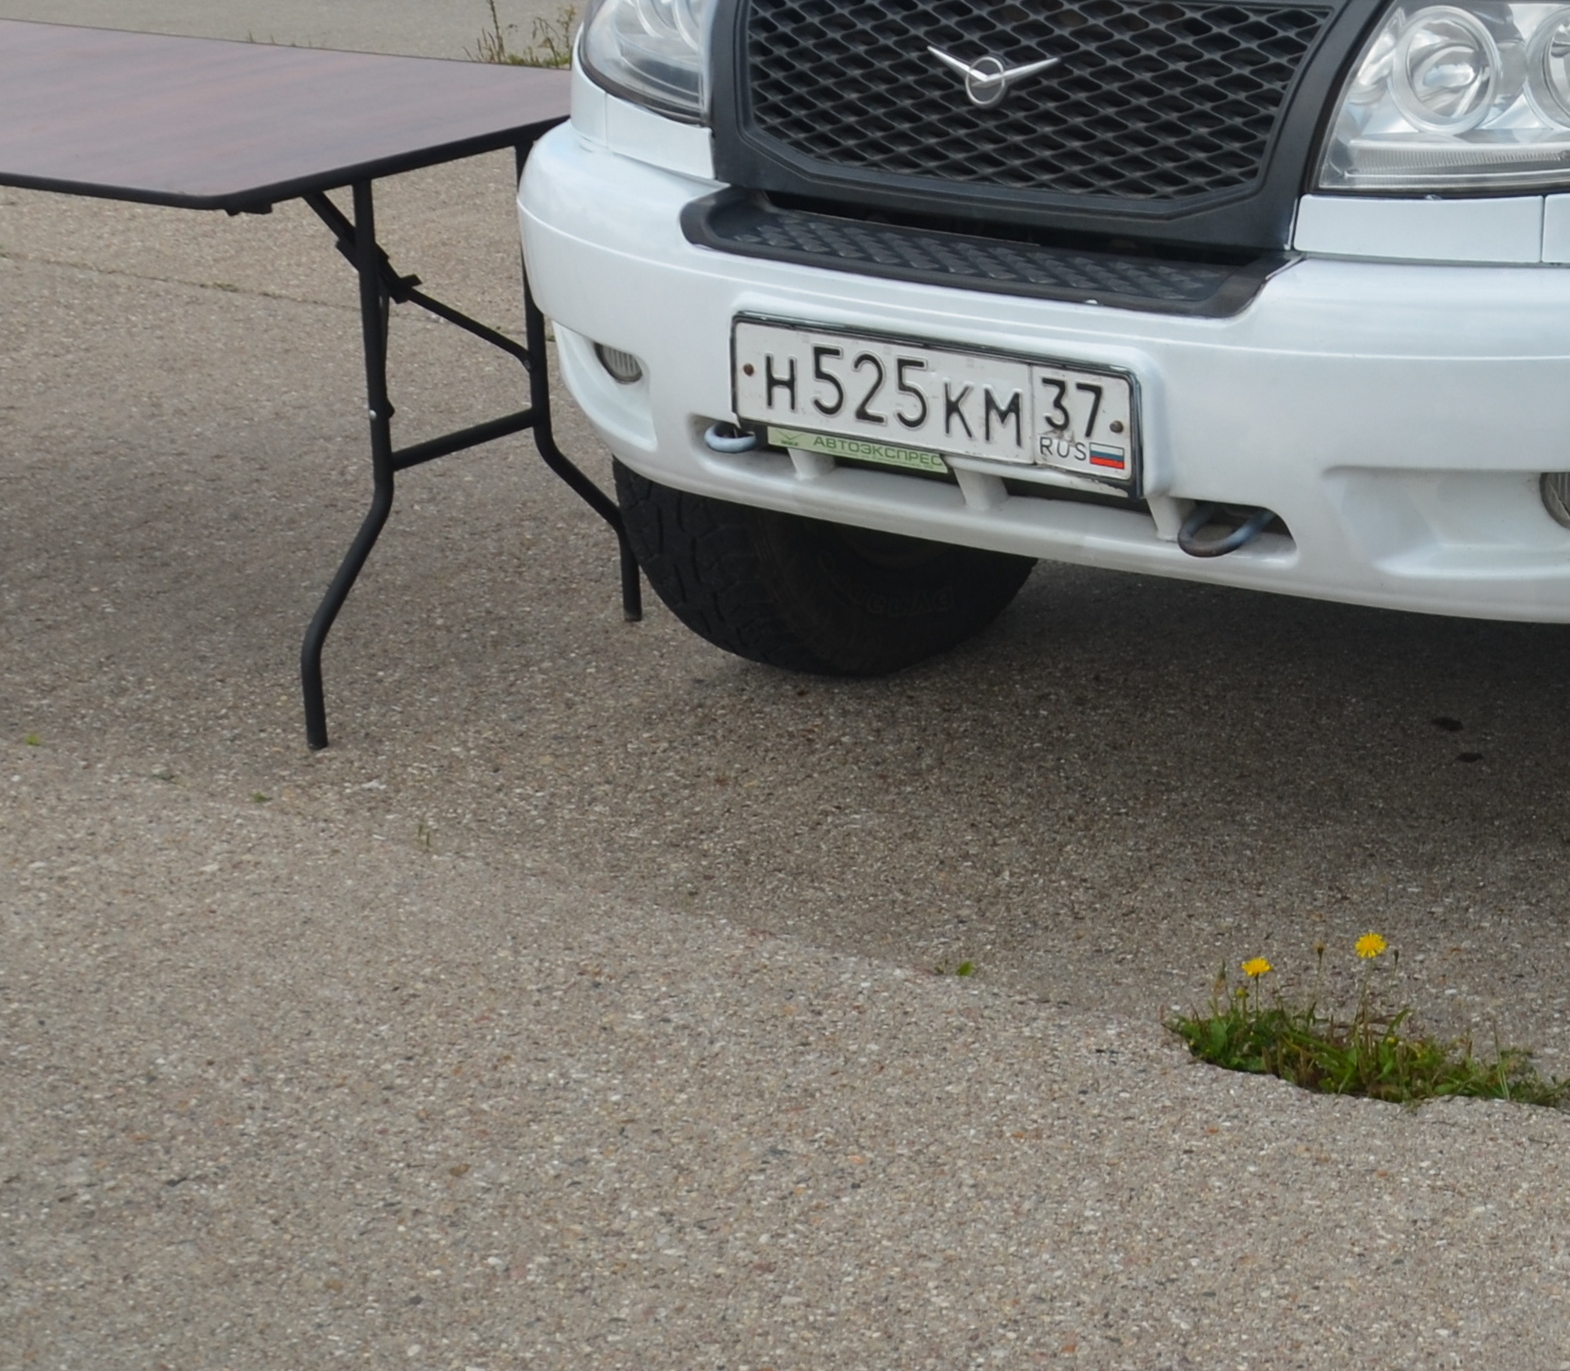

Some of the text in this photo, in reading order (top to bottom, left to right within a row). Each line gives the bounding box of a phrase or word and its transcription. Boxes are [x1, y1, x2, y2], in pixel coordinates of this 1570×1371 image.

[764, 345, 1105, 448] Н525КМ 37
[1038, 436, 1087, 462] RUS
